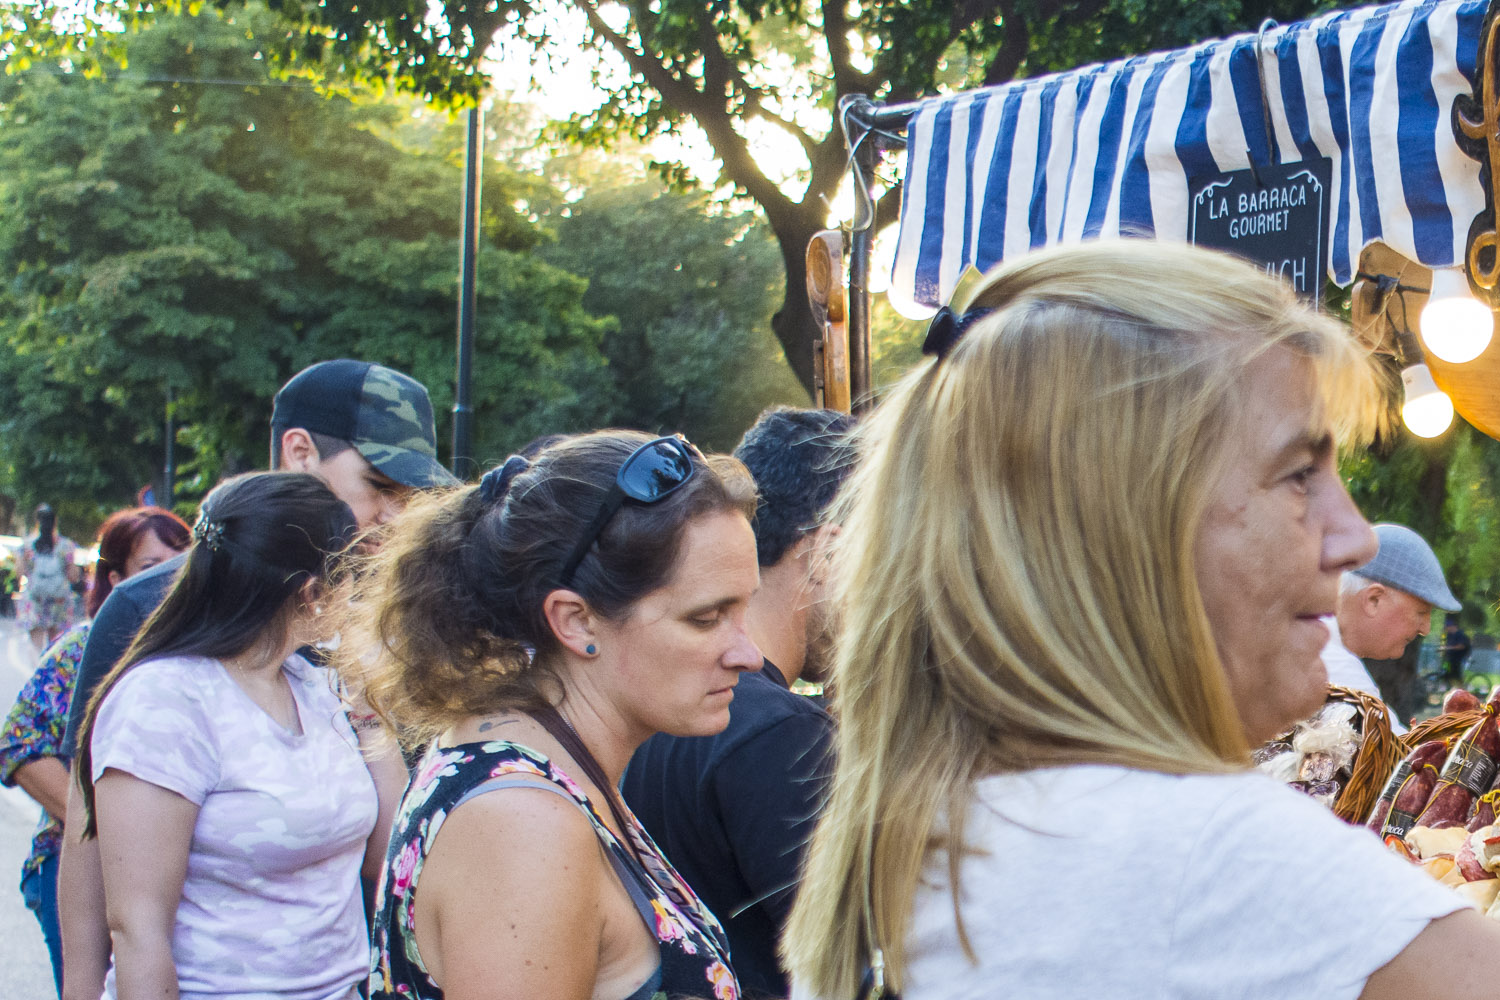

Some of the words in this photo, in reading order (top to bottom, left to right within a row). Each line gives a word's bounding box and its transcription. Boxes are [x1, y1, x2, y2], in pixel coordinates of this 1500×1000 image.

[1209, 198, 1229, 220] LA
[1238, 185, 1306, 213] BARRACA
[1229, 210, 1290, 239] GOURMET
